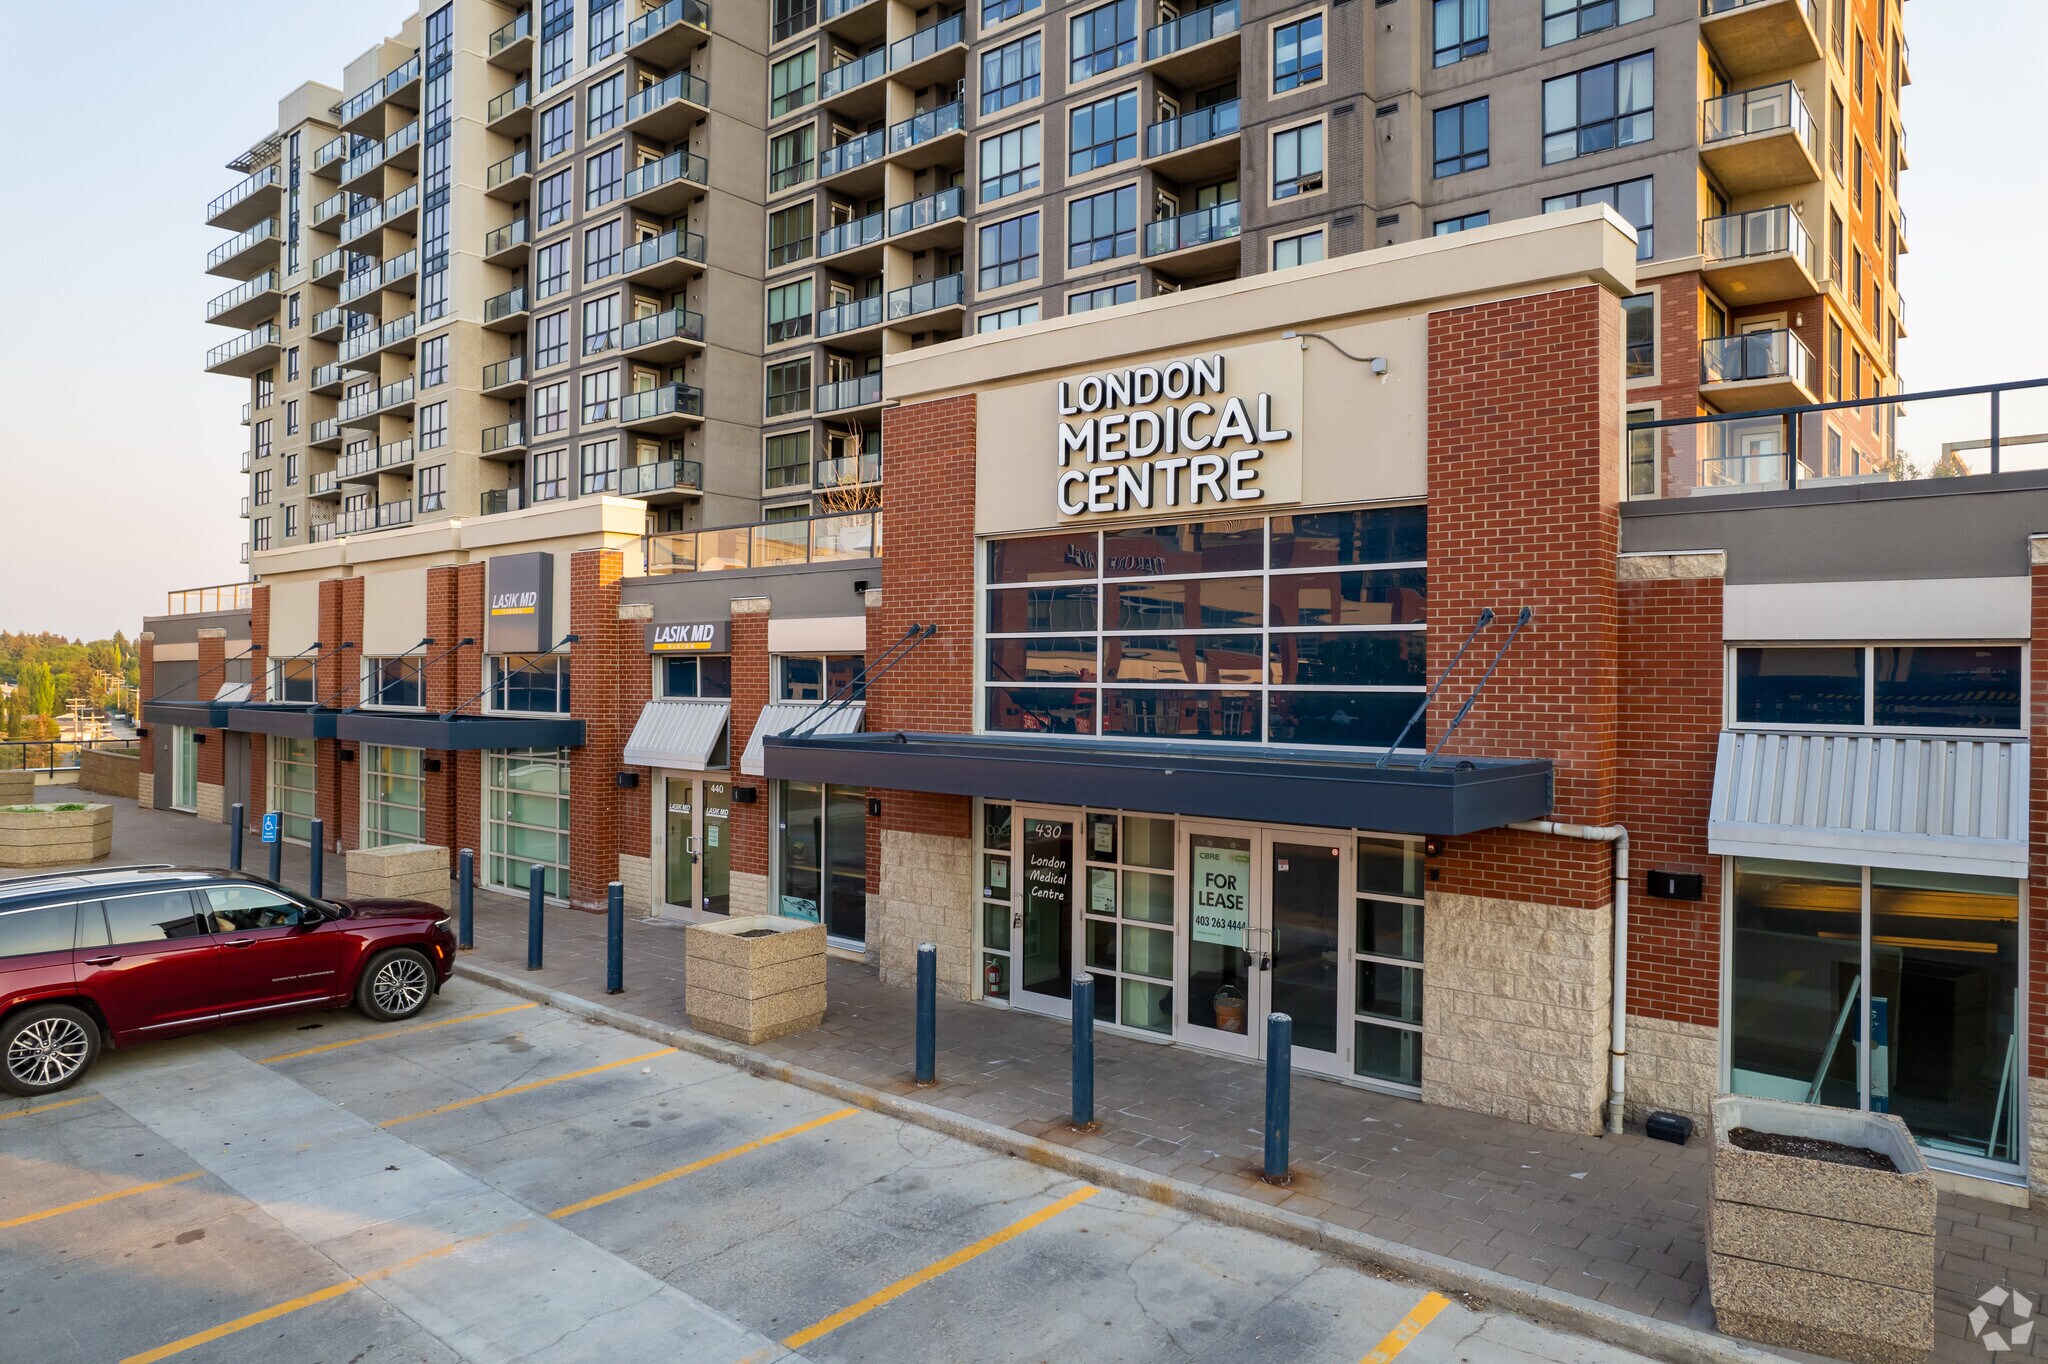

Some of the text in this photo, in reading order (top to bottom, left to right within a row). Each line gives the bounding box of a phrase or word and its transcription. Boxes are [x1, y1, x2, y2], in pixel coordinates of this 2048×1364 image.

[1057, 354, 1225, 416] LONDON
[1057, 392, 1292, 467] MEDICAL
[1057, 449, 1264, 516] CENTRE
[492, 591, 537, 608] LASIK MD
[654, 624, 715, 643] LASIK MD
[710, 784, 724, 794] 440
[706, 807, 729, 816] LASIK MD
[1035, 823, 1062, 839] 430
[1030, 854, 1066, 869] London
[1199, 852, 1220, 860] CBRE
[1029, 869, 1067, 885] Medical
[1205, 872, 1237, 890] FOR
[1031, 886, 1065, 900] Centre
[1198, 890, 1244, 911] LEASE
[1195, 915, 1246, 931] 403 263 4444
